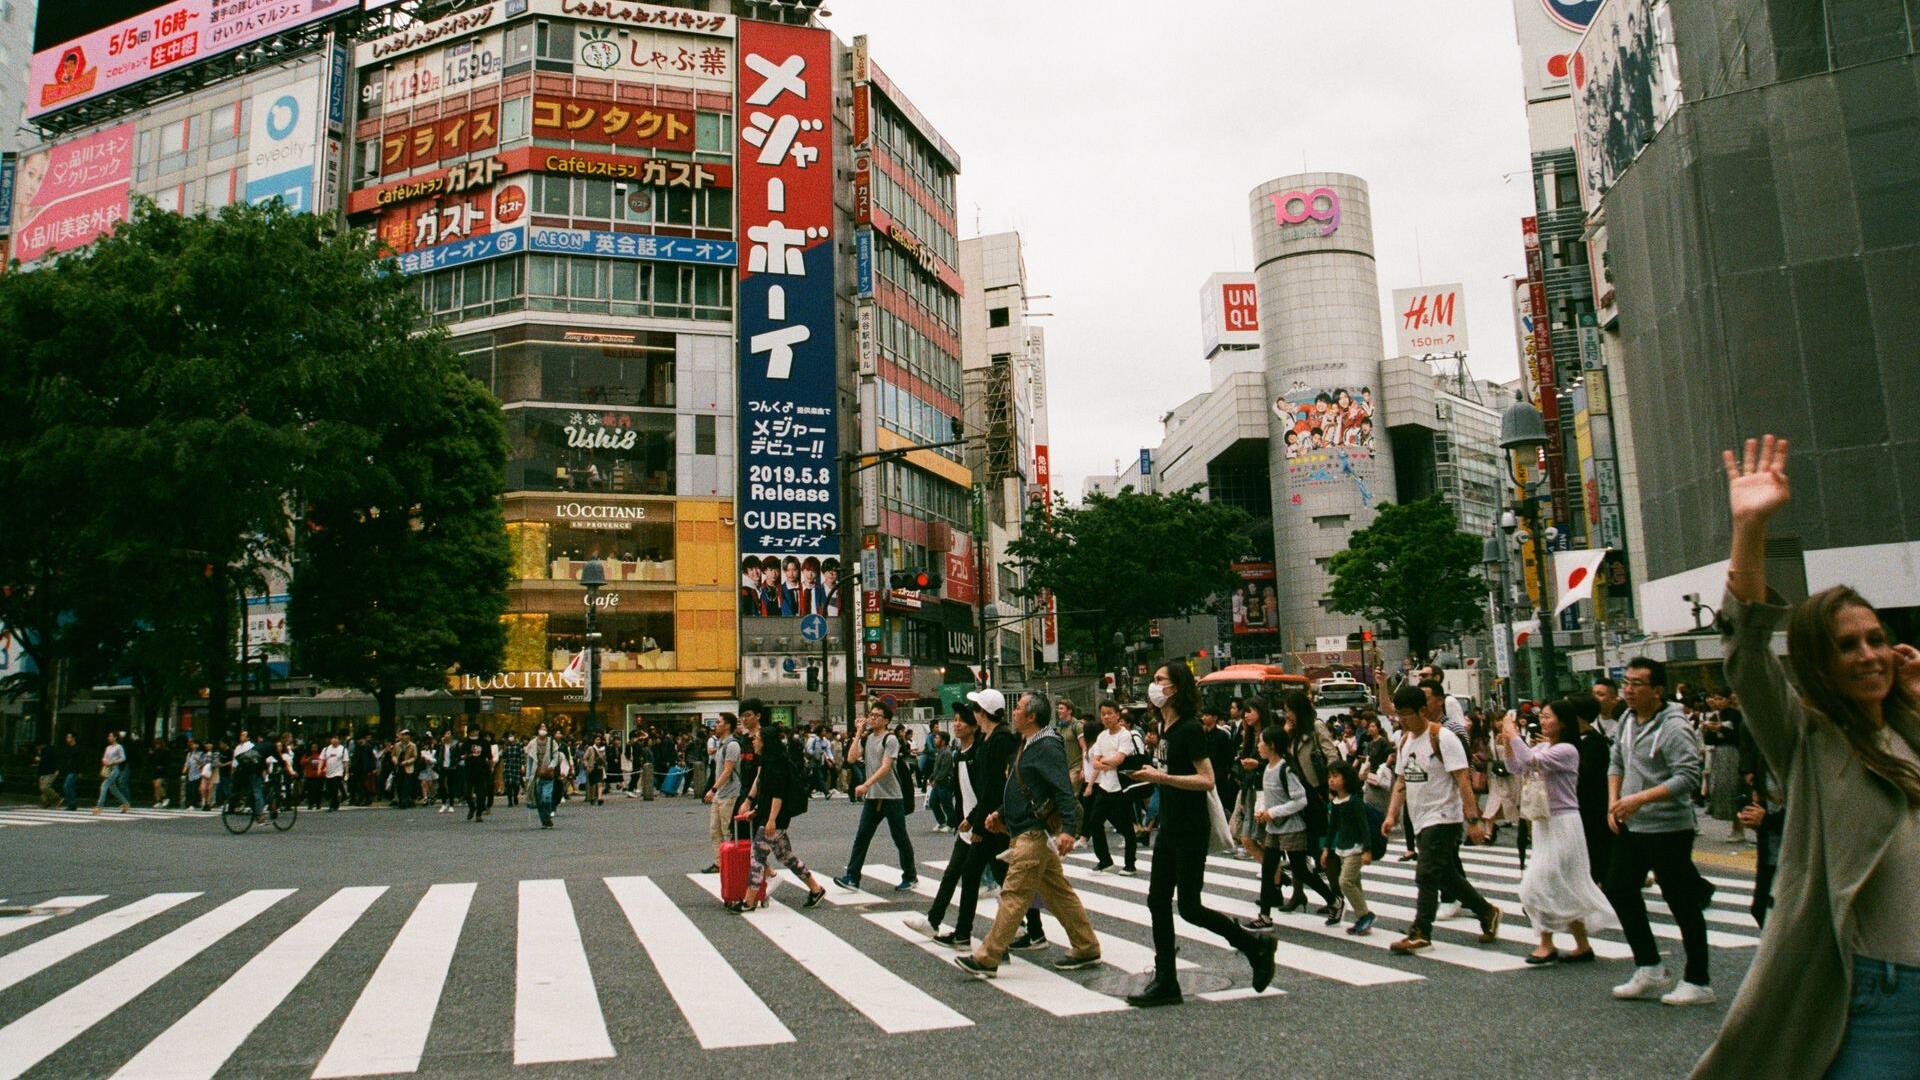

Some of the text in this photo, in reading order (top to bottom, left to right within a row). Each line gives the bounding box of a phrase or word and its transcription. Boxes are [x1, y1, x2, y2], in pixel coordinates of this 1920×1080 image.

[562, 0, 726, 32] しゃぶしゃぶバイキング
[372, 6, 494, 58] しゃぶしゃぶバイキング
[152, 34, 196, 66] 生中継
[631, 39, 727, 76] しゃぶ葉
[362, 82, 383, 103] 9F
[534, 101, 690, 141] コンタクト
[69, 136, 130, 168] 品川スキン
[385, 111, 496, 165] プライス
[256, 141, 306, 166] eyecity
[68, 158, 120, 188] クリニック
[446, 158, 504, 193] ガスト
[642, 159, 715, 189] ガスト
[499, 200, 523, 215] ガスト
[742, 53, 829, 379] メジャーボーイ
[858, 185, 868, 217] ガスト
[1269, 187, 1341, 237] 109
[31, 203, 122, 250] 品川美容外科
[415, 202, 484, 247] ガスト
[499, 235, 515, 248] 6F
[536, 231, 733, 261] AEON 英会話イーオン
[1403, 292, 1455, 330] H&M
[1411, 336, 1444, 348] 150m
[563, 426, 638, 450] Ushi8
[752, 416, 826, 438] メジャー
[749, 465, 830, 484] 2019.5.8
[751, 484, 830, 502] Release
[556, 503, 645, 519] L'OCCITANE
[743, 510, 836, 531] CUBERS
[759, 534, 827, 547] キューバーズ
[951, 558, 969, 581] アコム
[584, 593, 619, 608] Café
[948, 631, 974, 656] LUSH
